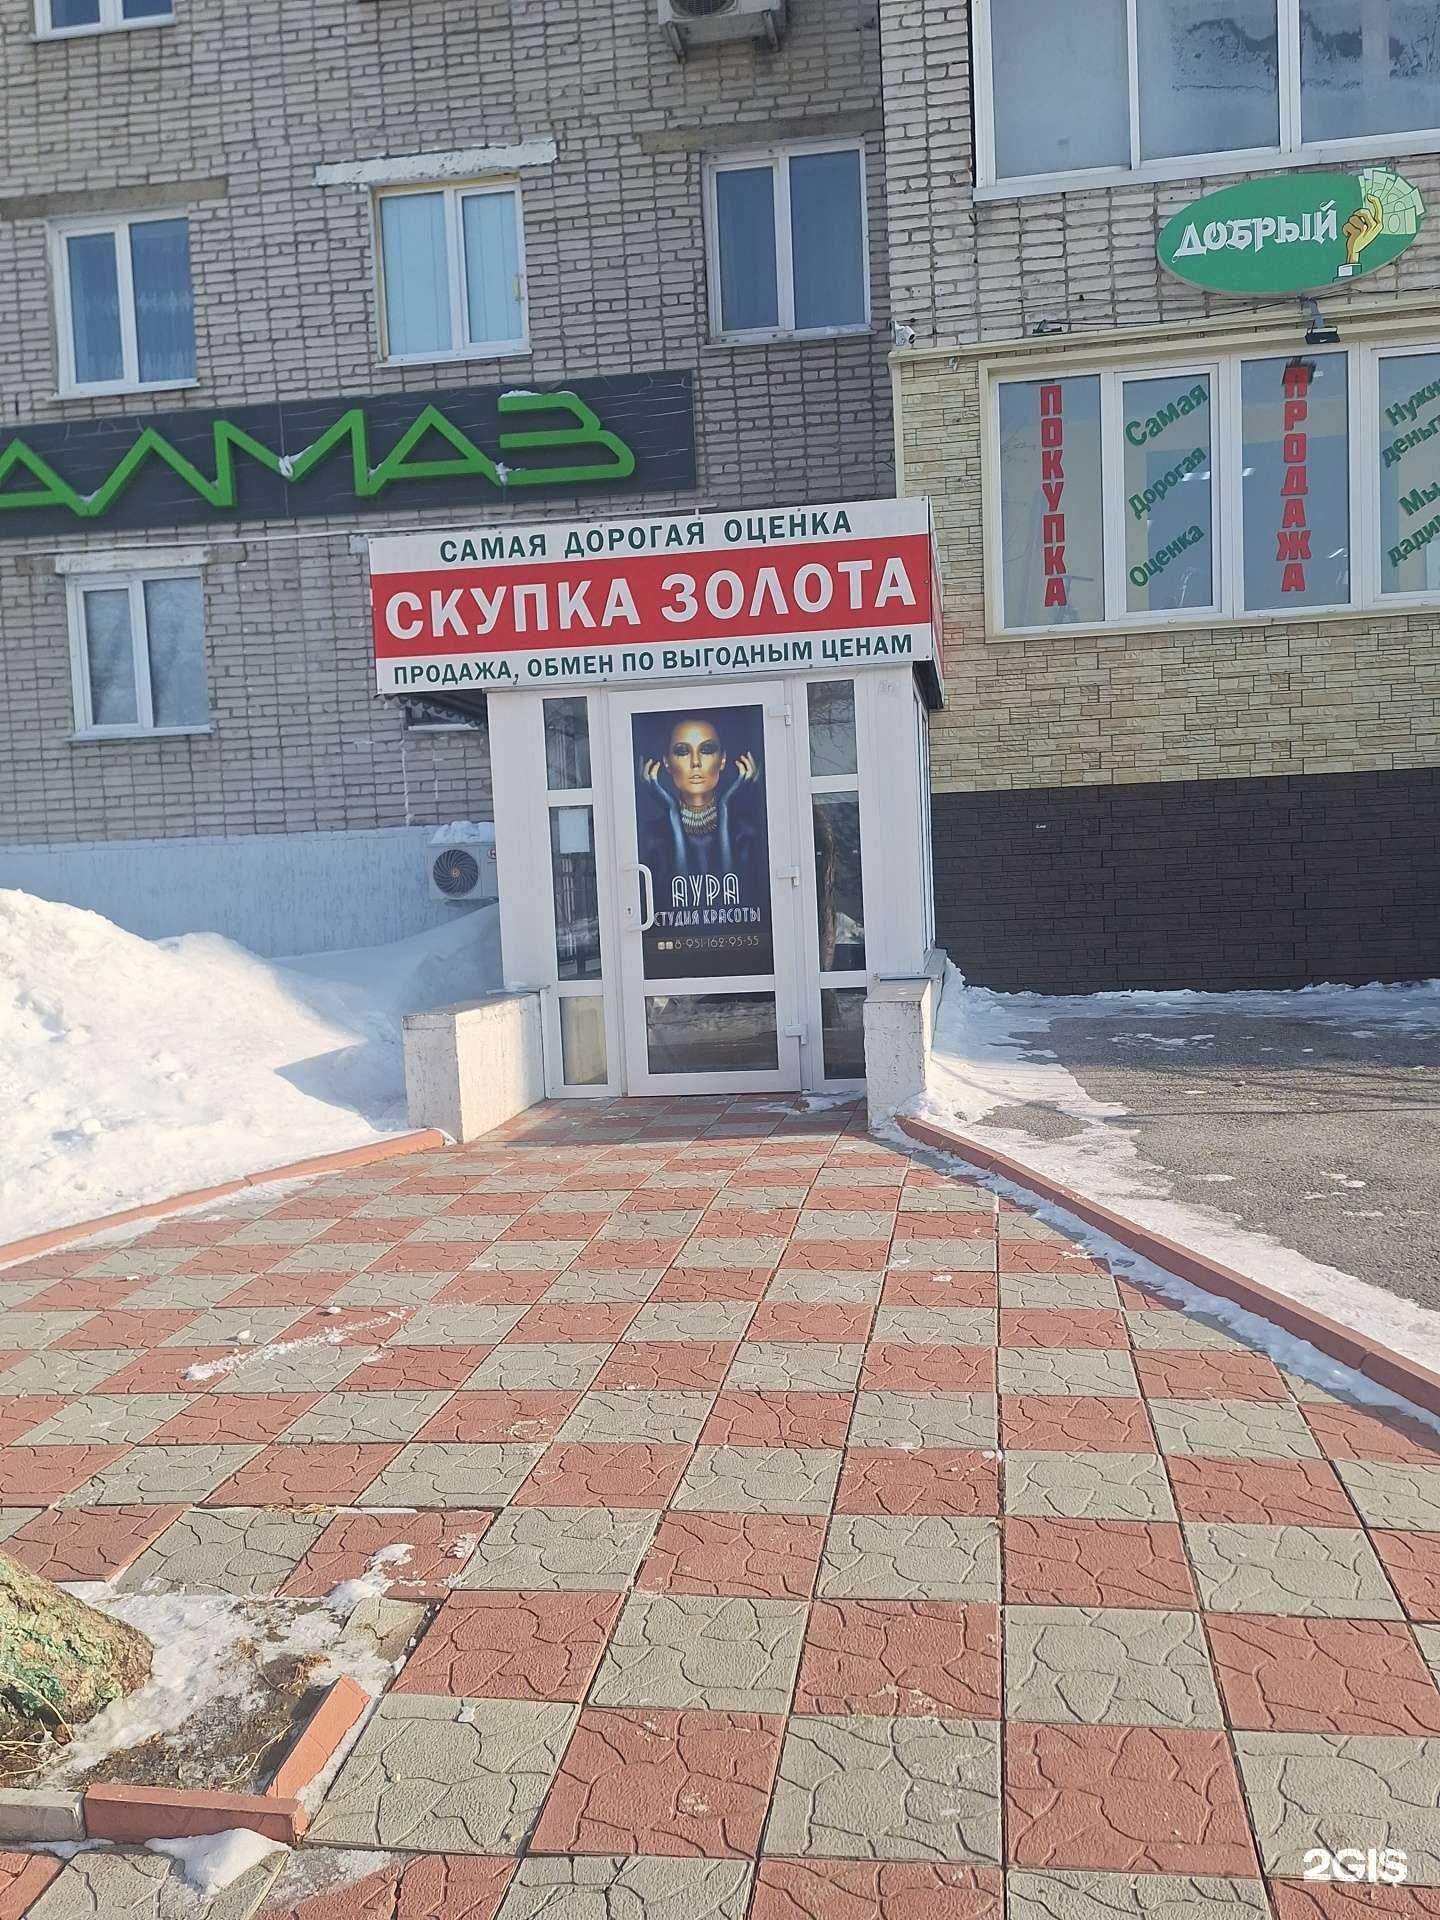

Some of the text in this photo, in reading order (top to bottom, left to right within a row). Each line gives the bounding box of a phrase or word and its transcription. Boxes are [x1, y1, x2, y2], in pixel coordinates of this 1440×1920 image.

[1172, 199, 1338, 263] ДОБРЫЙ
[1125, 384, 1209, 446] Самая
[1385, 378, 1440, 426] Нужн
[0, 392, 636, 518] АЛМАЗ
[1382, 414, 1440, 468] деньг
[1040, 384, 1067, 608] ПОКУПКА
[1128, 447, 1207, 520] Дорогая
[1276, 367, 1312, 592] ПРОДАЖА
[440, 510, 852, 563] САМАЯ ДОРОГАЯ ОЦЕНКА
[1129, 524, 1205, 588] Оценка
[1388, 514, 1440, 568] дади
[384, 557, 917, 641] СКУПКА ЗОЛОТА
[393, 633, 913, 686] ПРОДАЖА, ОБМЕН ПО ВЫГОДНЫМ ЦЕНАМ
[654, 907, 761, 927] СТУДИЯ КРАСОТЫ
[671, 873, 740, 908] АУРА
